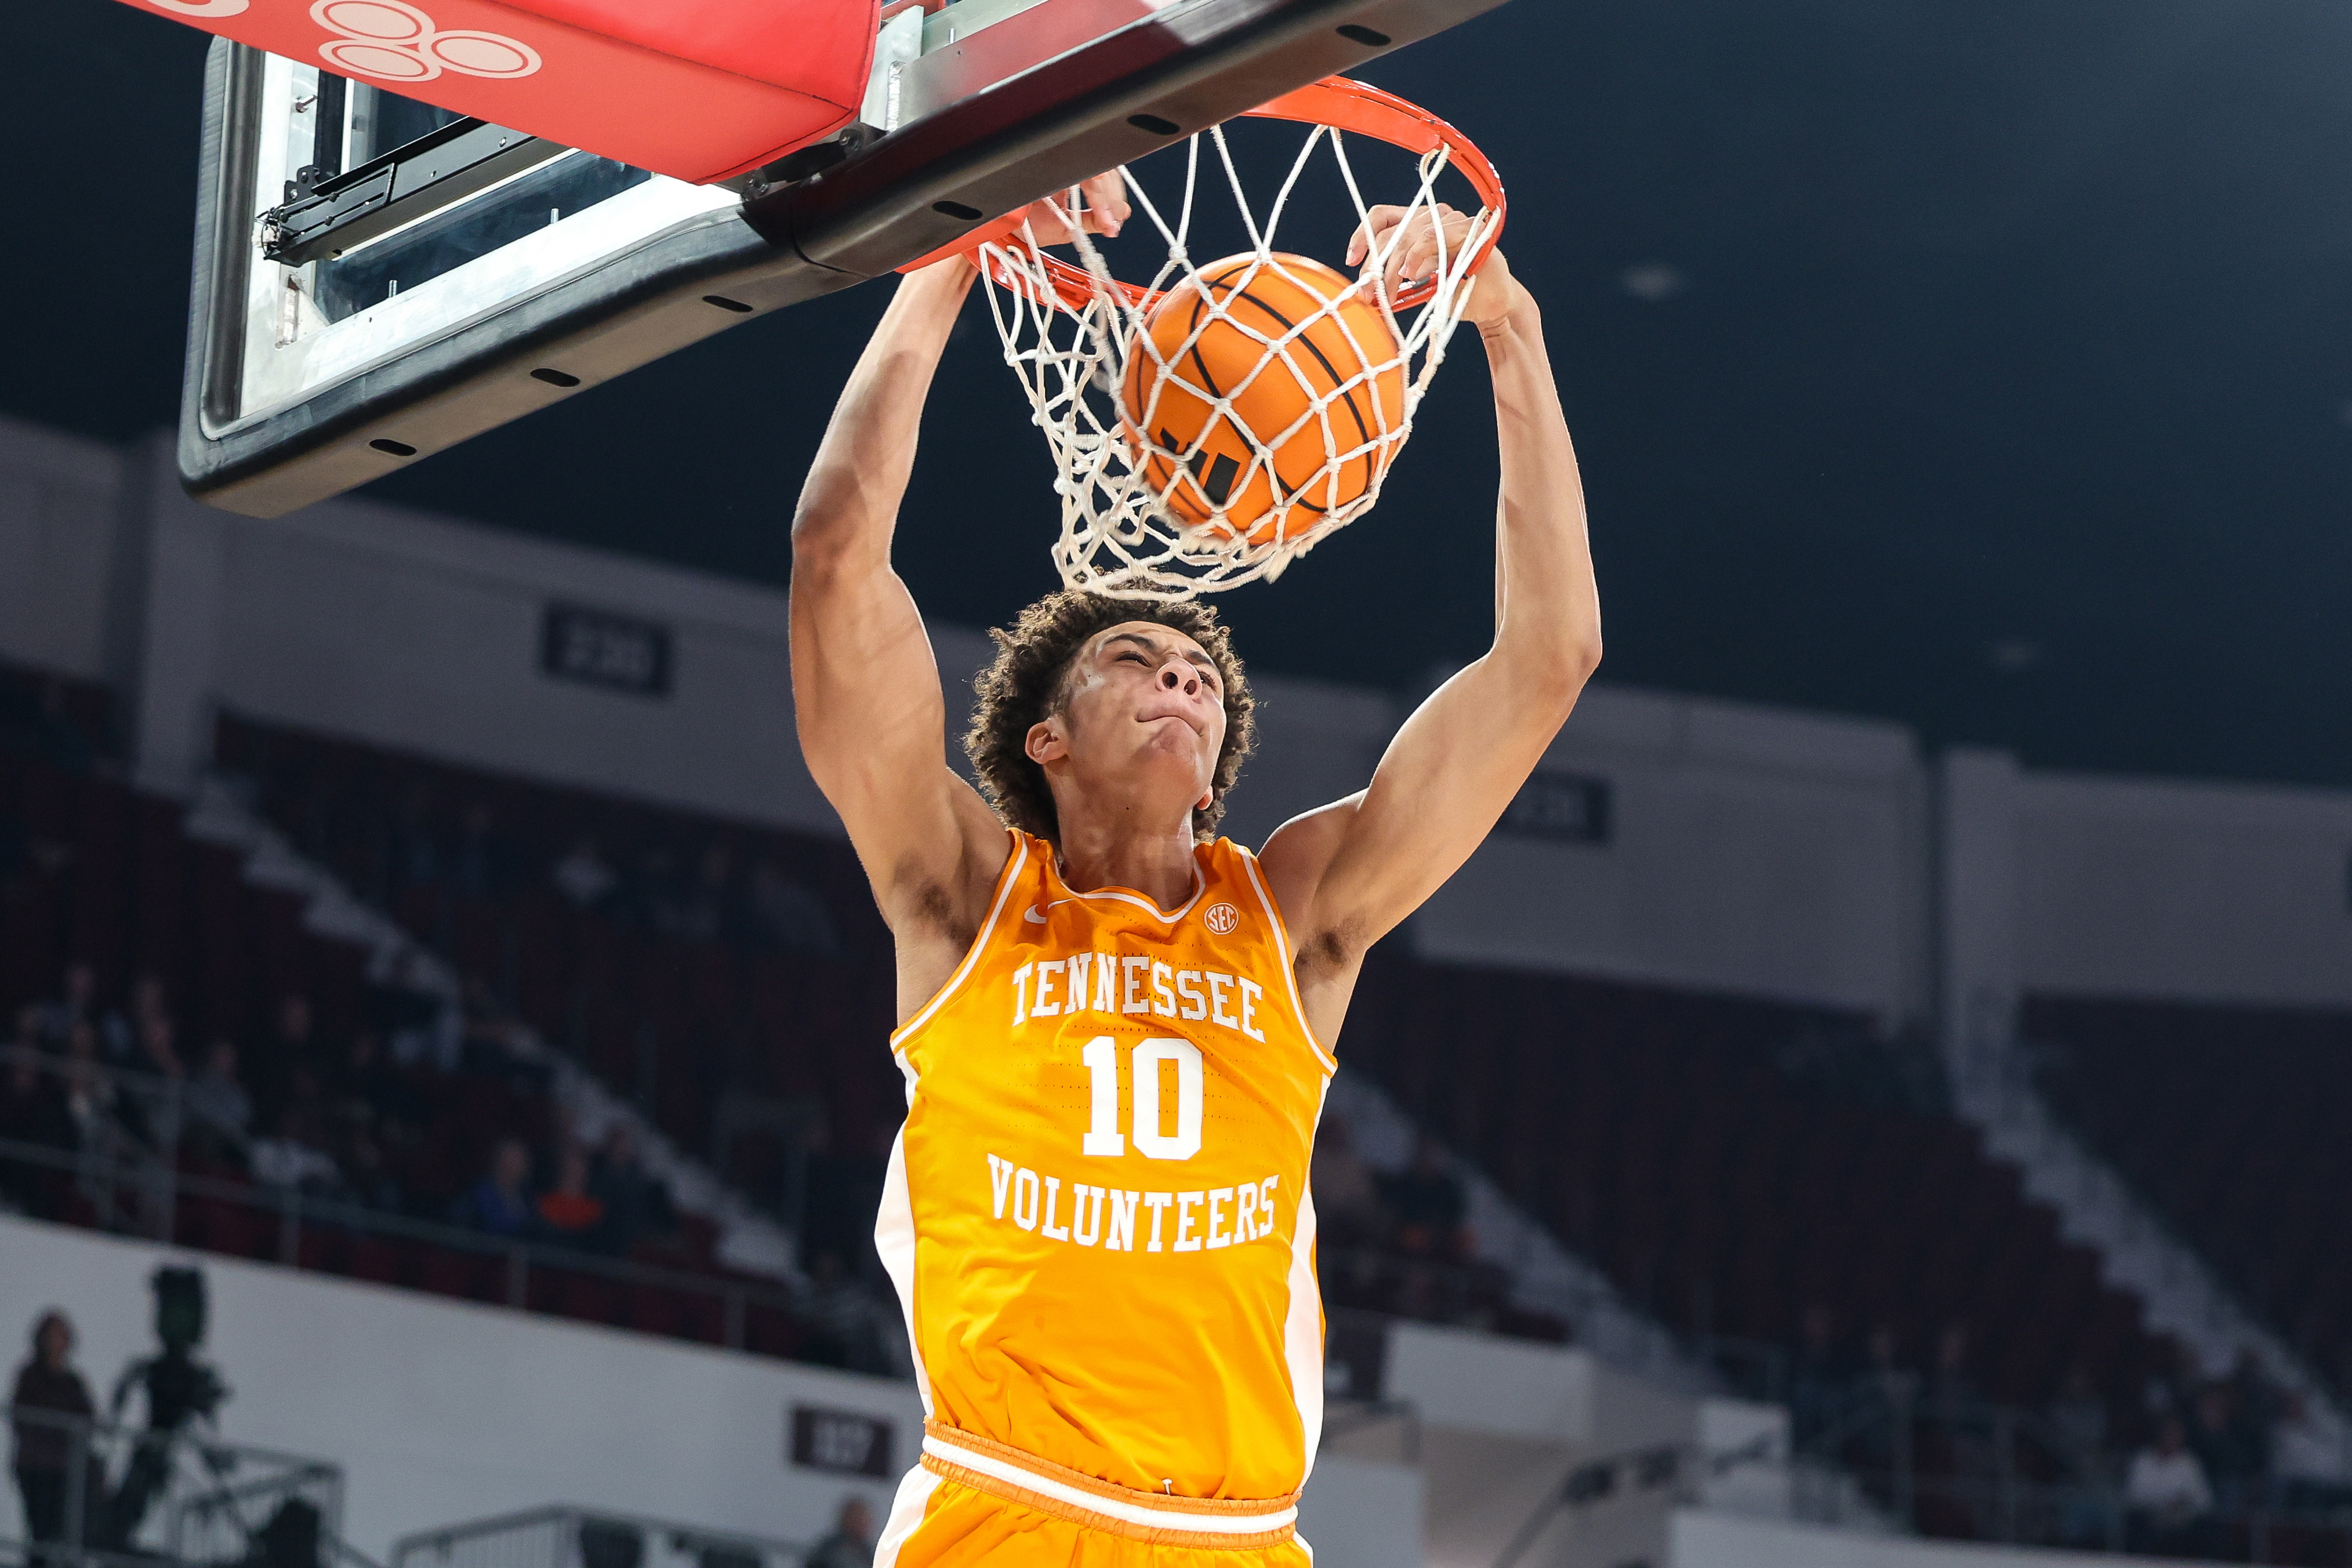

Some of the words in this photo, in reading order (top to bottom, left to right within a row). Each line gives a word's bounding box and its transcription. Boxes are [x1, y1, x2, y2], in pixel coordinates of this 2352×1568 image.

[1207, 905, 1236, 932] SEC
[1011, 952, 1266, 1044] TENNESSEE
[1082, 1035, 1203, 1160] 10
[986, 1152, 1280, 1253] VOLUNTEERS
